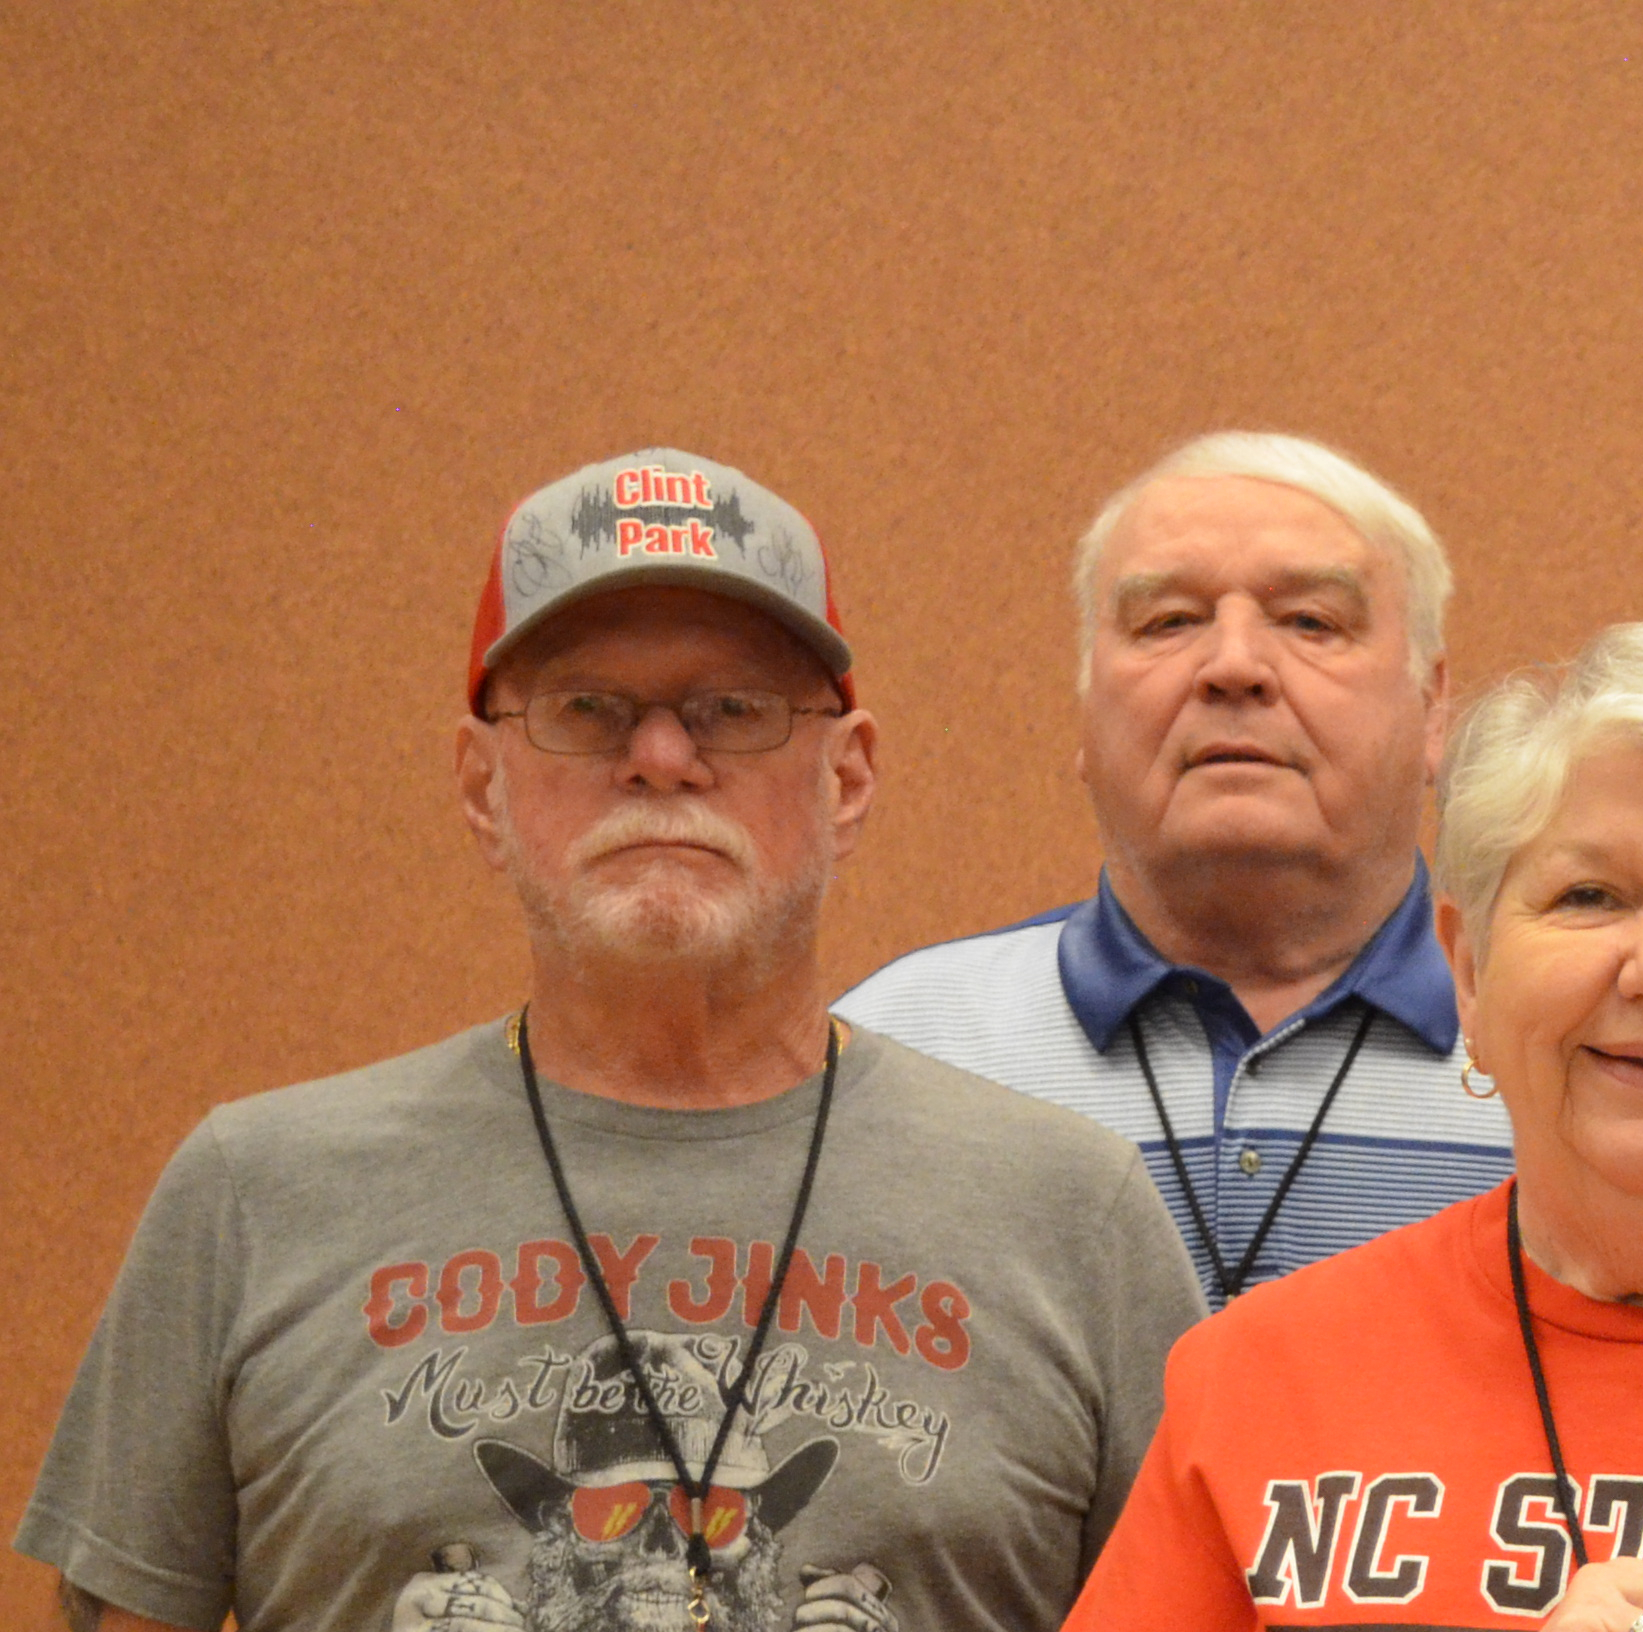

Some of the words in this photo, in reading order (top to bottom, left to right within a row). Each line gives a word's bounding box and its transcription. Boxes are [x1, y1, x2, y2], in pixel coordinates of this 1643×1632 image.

[614, 465, 713, 510] Clint
[616, 517, 718, 560] Park
[363, 1233, 661, 1348] CODY
[667, 1236, 971, 1372] JINKS
[380, 1343, 572, 1441] Must
[571, 1359, 626, 1414] be
[694, 1334, 951, 1485] Whiskey
[1246, 1470, 1446, 1609] NC
